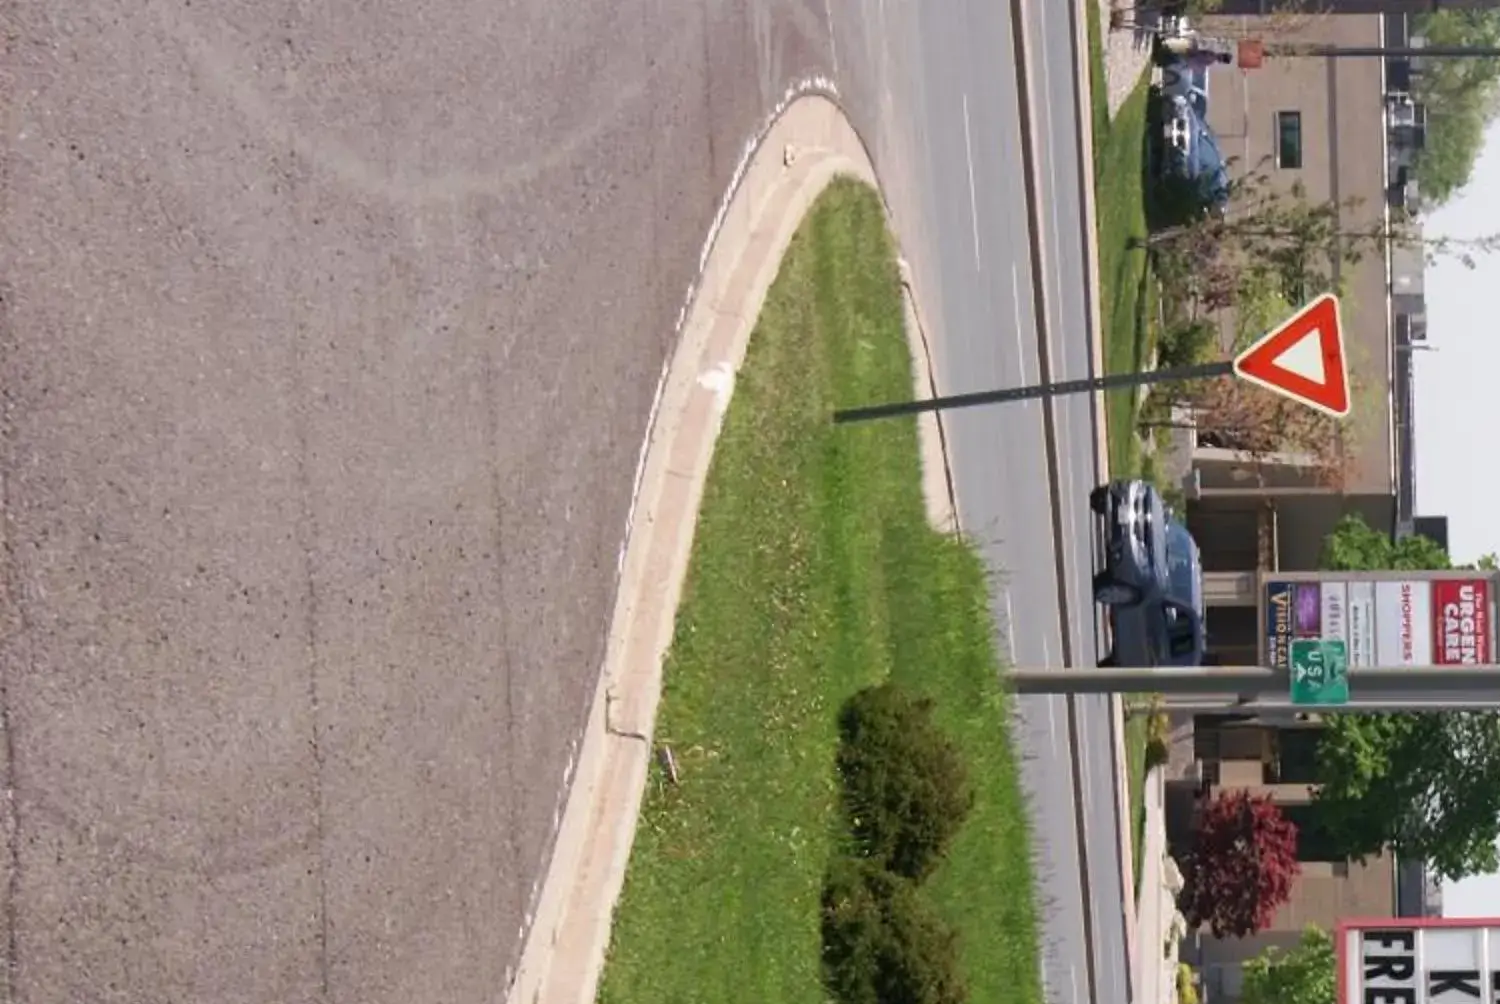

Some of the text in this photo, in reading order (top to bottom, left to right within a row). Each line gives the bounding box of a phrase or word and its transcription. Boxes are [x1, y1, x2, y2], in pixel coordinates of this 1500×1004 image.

[1401, 584, 1413, 662] SHOPPERS
[1444, 603, 1460, 661] CARE
[1307, 650, 1323, 693] USA
